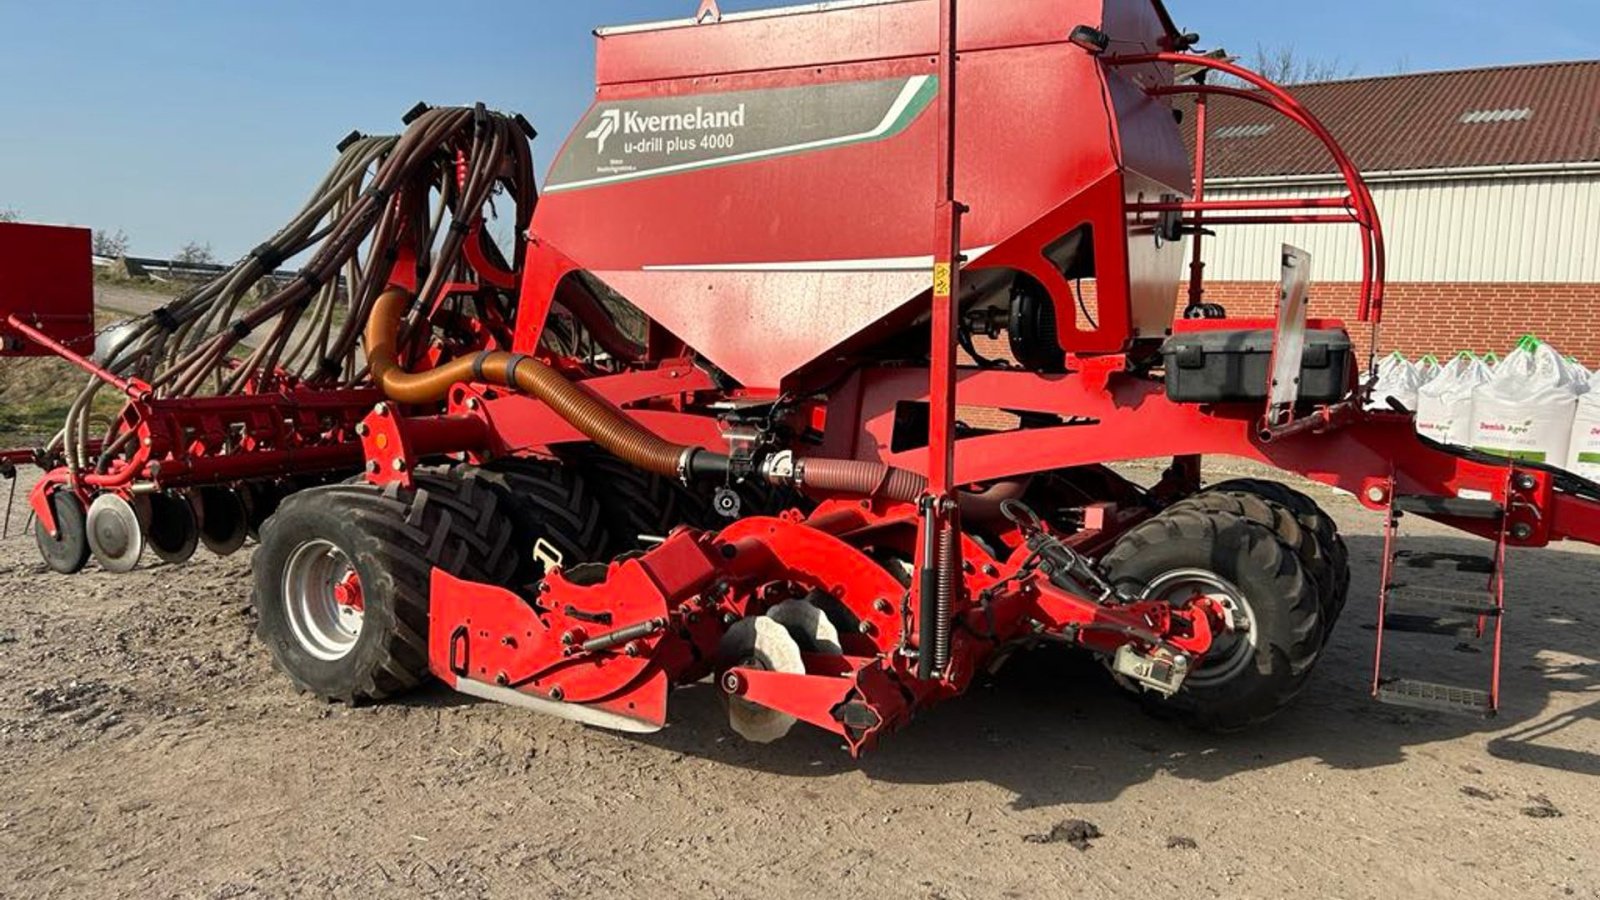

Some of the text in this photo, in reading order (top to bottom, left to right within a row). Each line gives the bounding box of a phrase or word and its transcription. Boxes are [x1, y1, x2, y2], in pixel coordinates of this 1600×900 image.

[623, 103, 745, 134] Kverneland
[624, 133, 734, 155] u-drill plus 4000
